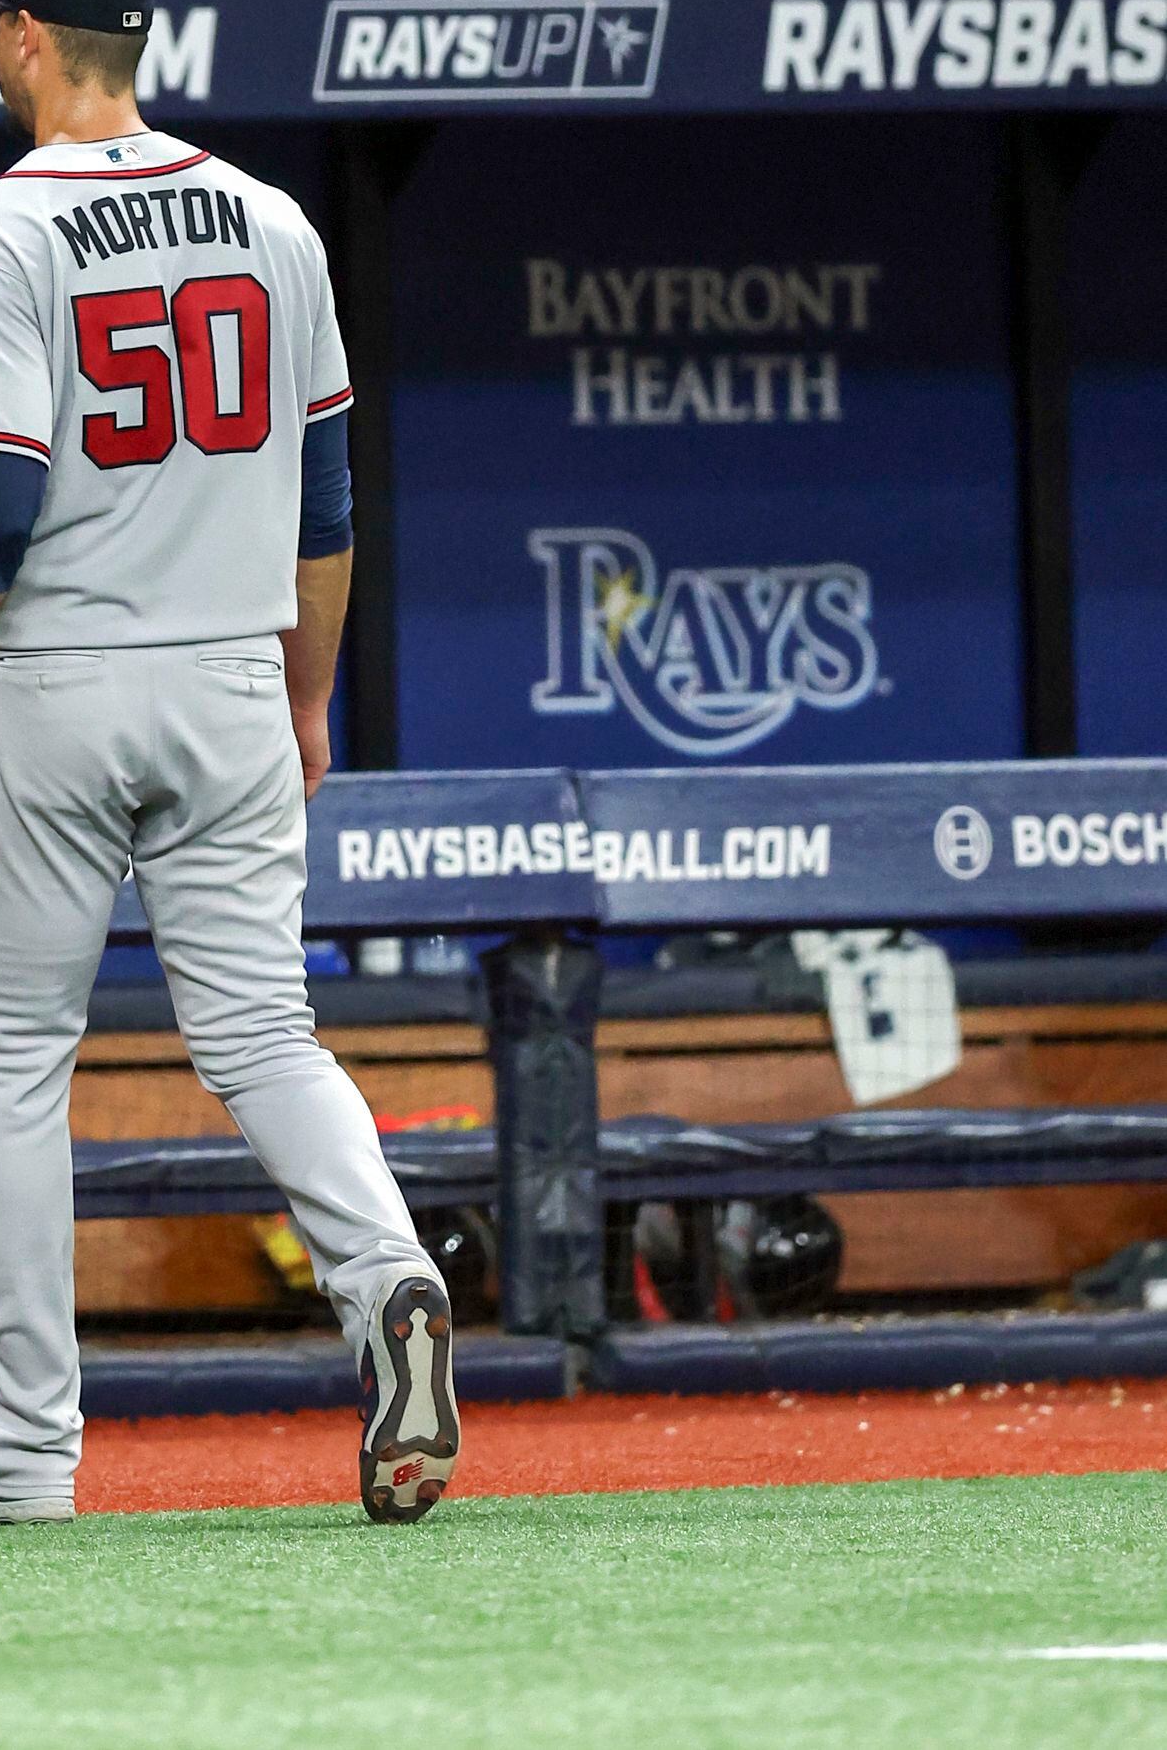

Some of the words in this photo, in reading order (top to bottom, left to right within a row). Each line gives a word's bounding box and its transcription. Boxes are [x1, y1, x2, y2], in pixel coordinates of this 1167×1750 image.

[337, 13, 576, 81] RAYSUP
[52, 186, 250, 270] MORTON
[70, 272, 271, 471] 50
[338, 820, 831, 883] RAYSBASEBALL.COM
[1010, 811, 1167, 869] BOSCH
